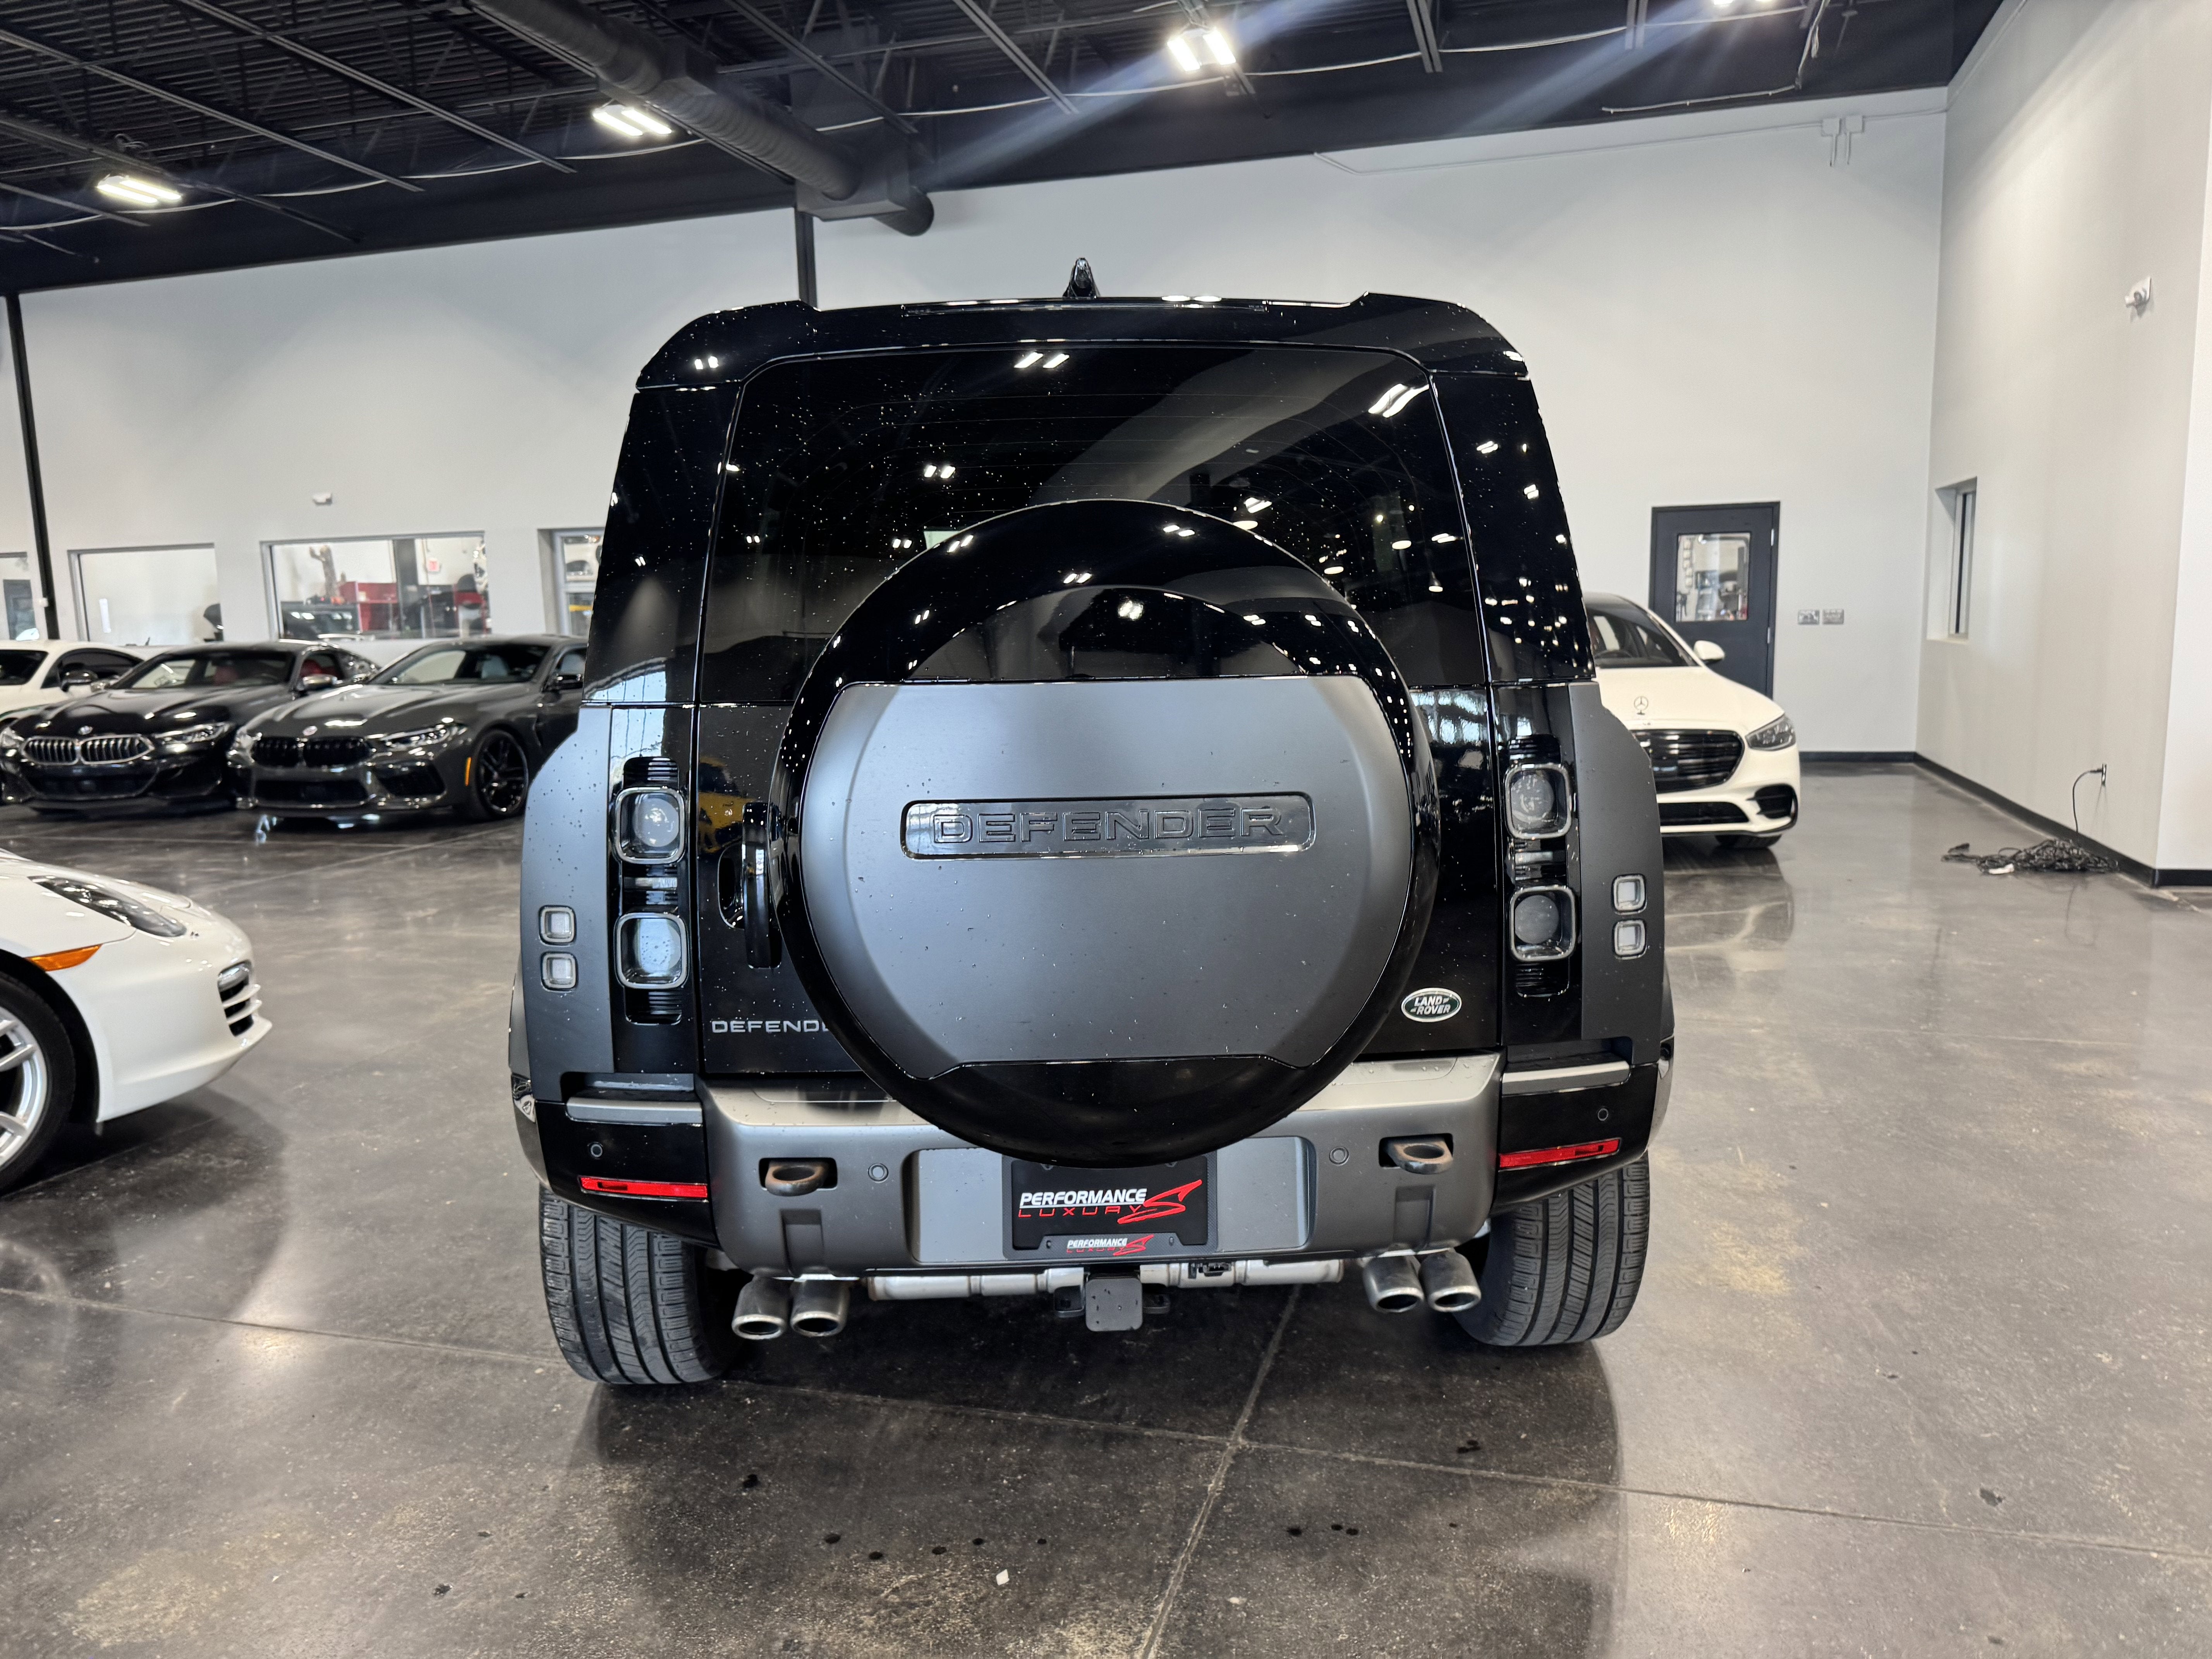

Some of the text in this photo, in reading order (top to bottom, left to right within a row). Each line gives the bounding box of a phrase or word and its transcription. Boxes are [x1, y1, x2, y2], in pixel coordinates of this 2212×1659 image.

[931, 807, 1283, 843] DEFENDER
[1414, 996, 1443, 1006] LAND
[1416, 1004, 1451, 1015] ROVER
[1020, 1188, 1147, 1206] PERFORMANCE
[1018, 1205, 1141, 1218] LUXURY
[1067, 1238, 1128, 1248] PERFORMANCE
